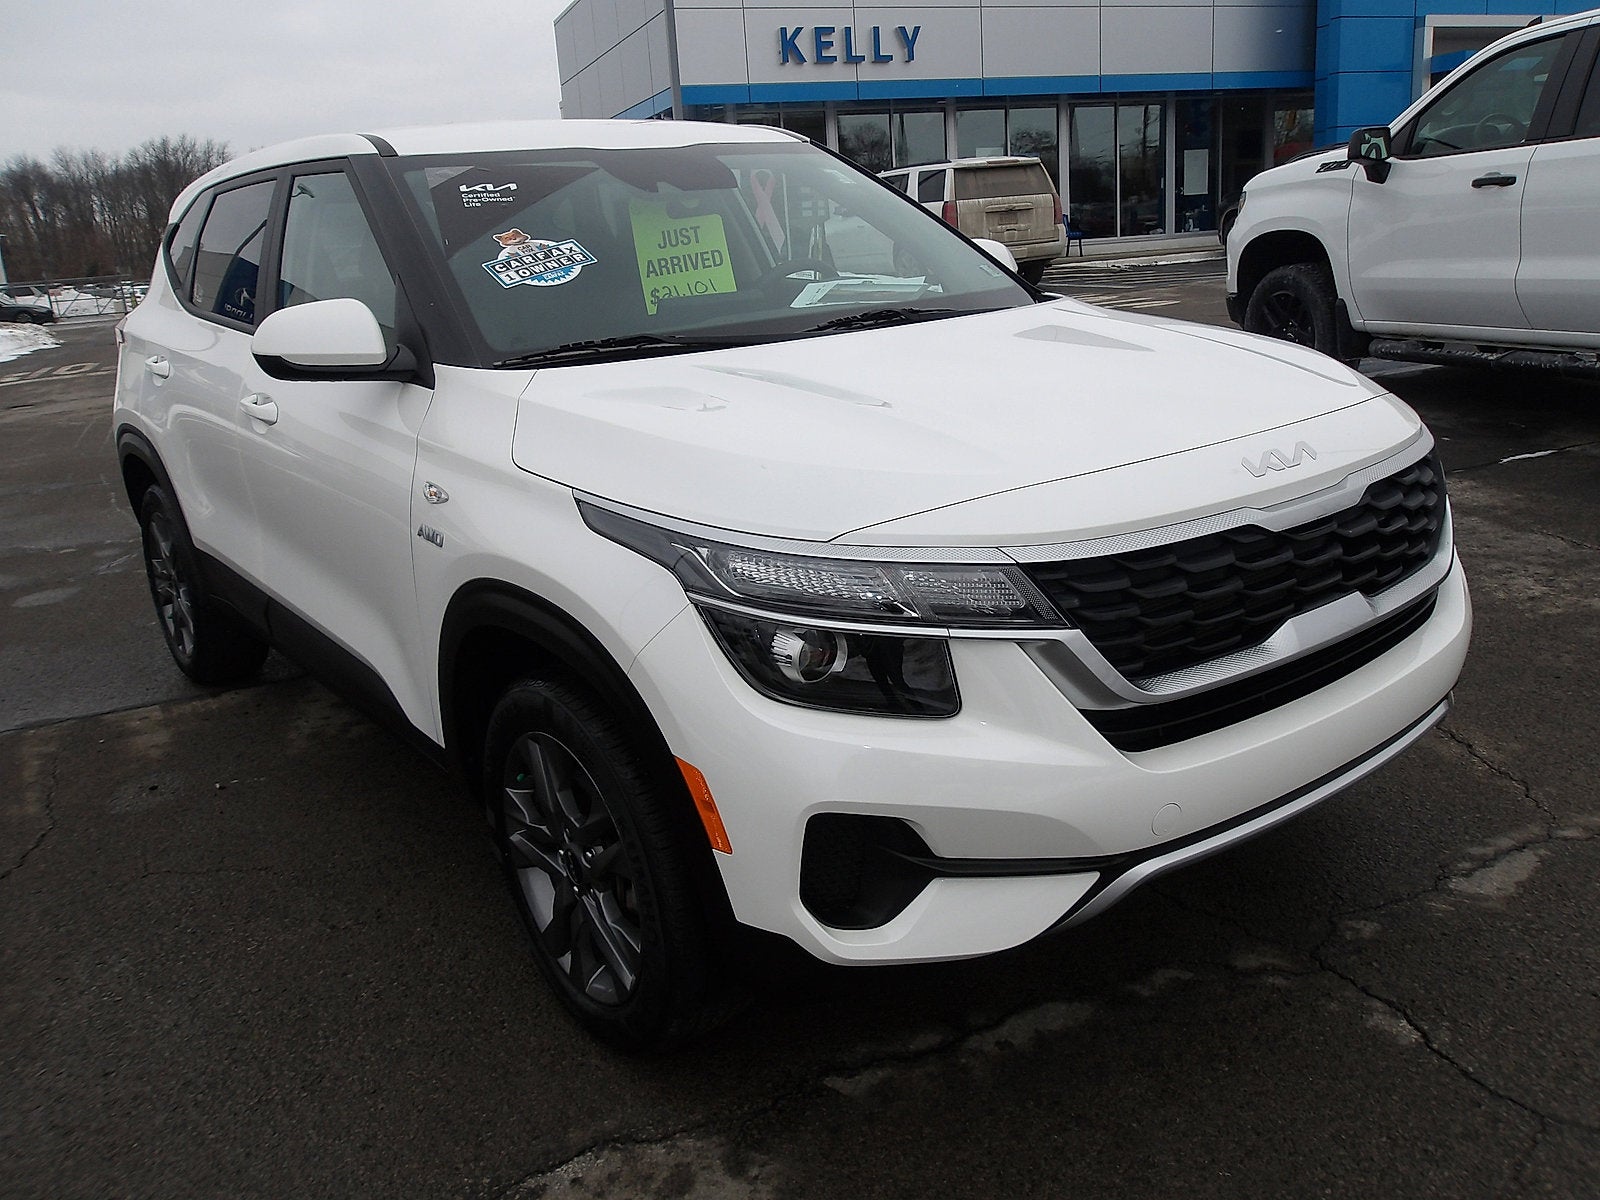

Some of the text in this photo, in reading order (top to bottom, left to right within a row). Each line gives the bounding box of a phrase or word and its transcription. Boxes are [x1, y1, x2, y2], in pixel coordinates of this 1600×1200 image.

[779, 25, 921, 64] KELLY
[658, 226, 700, 249] JUST
[494, 245, 577, 273] CARFAX
[504, 273, 517, 282] 1
[517, 253, 587, 277] OWNER
[646, 249, 724, 278] ARRIVED
[417, 523, 445, 548] AWD
